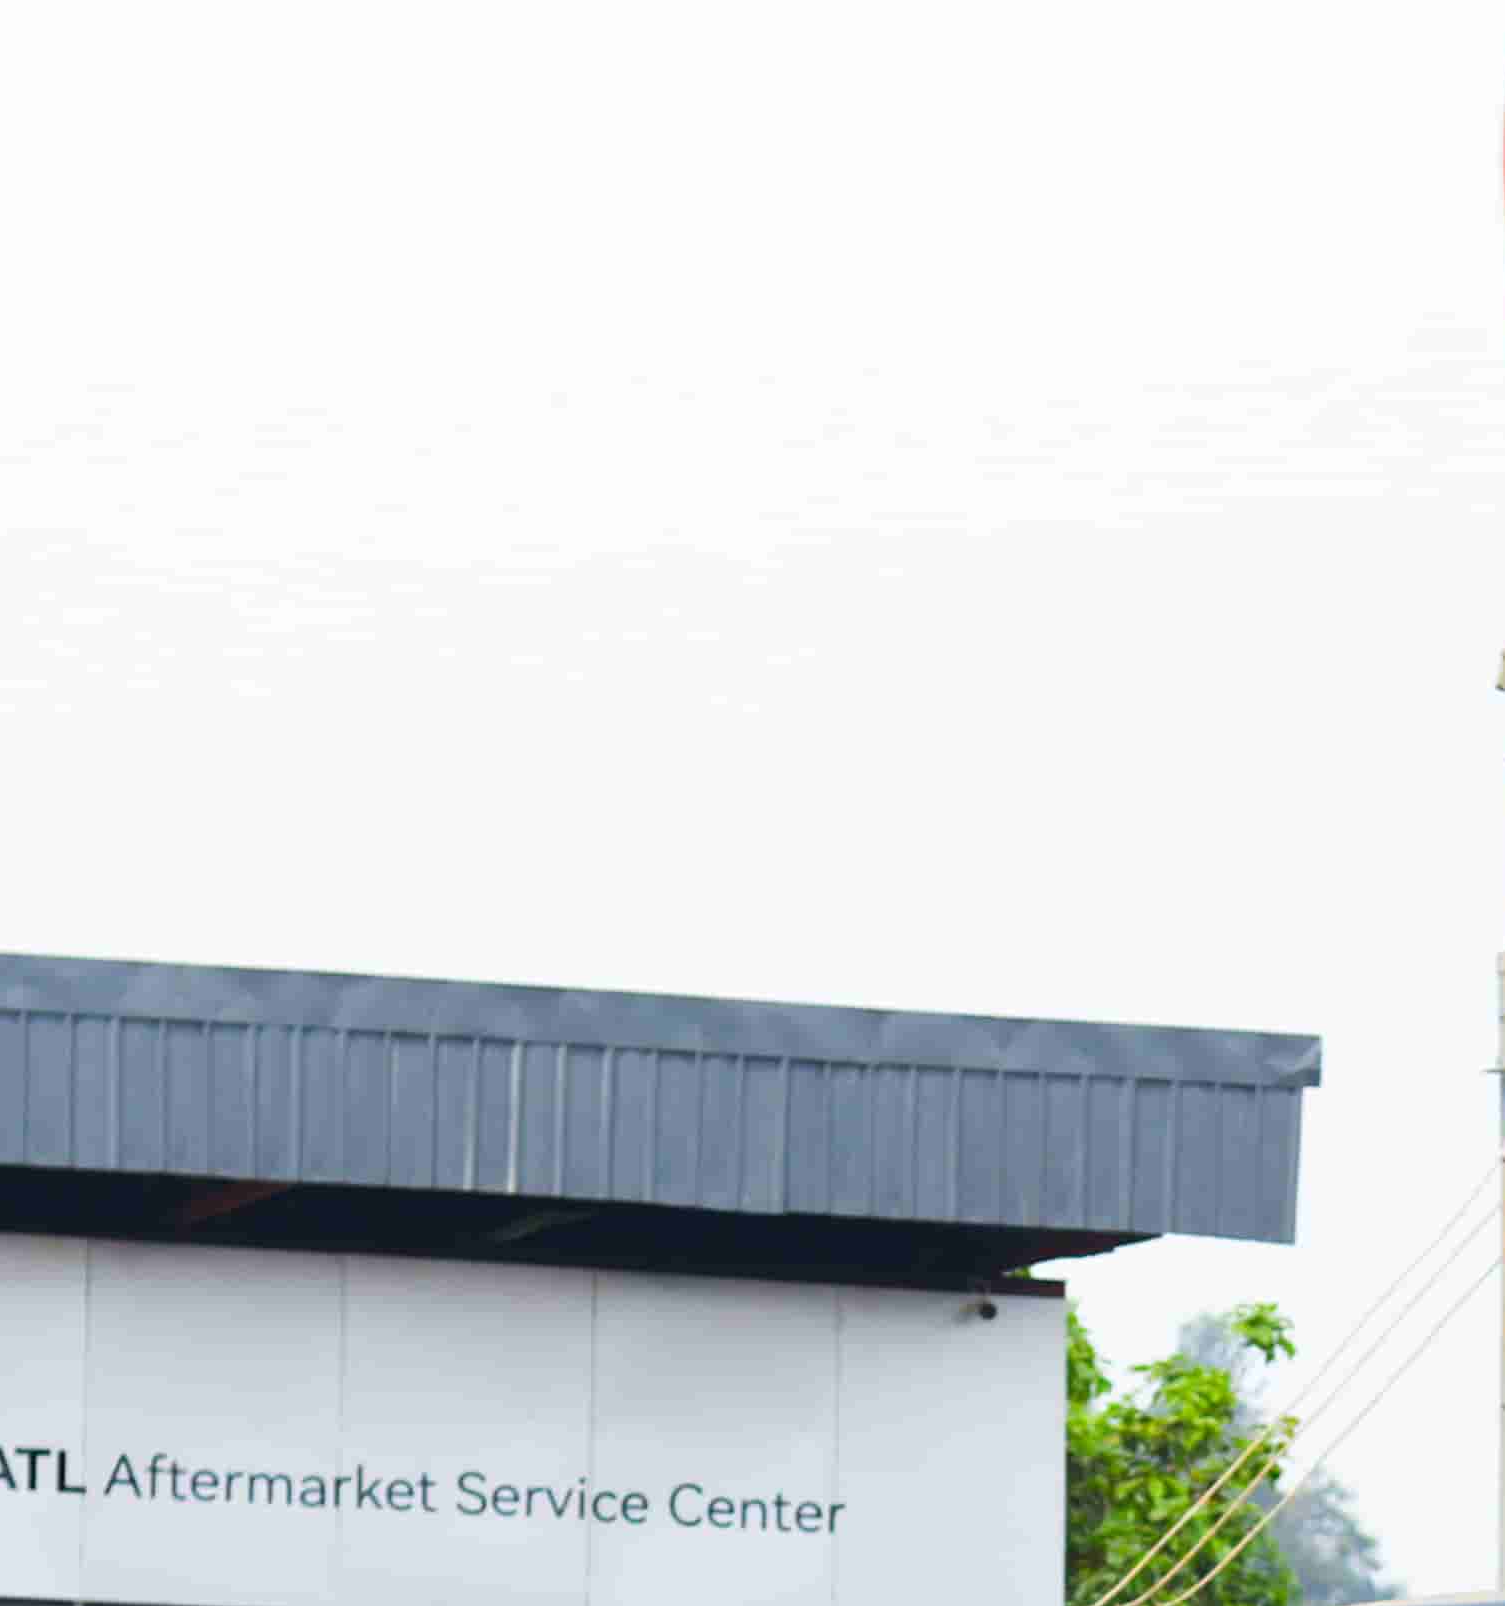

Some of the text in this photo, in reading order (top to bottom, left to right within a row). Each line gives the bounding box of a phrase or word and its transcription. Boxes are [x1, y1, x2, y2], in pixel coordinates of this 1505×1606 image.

[103, 1453, 437, 1515] Aftermarket
[456, 1470, 649, 1525] Service
[668, 1482, 846, 1534] Center
